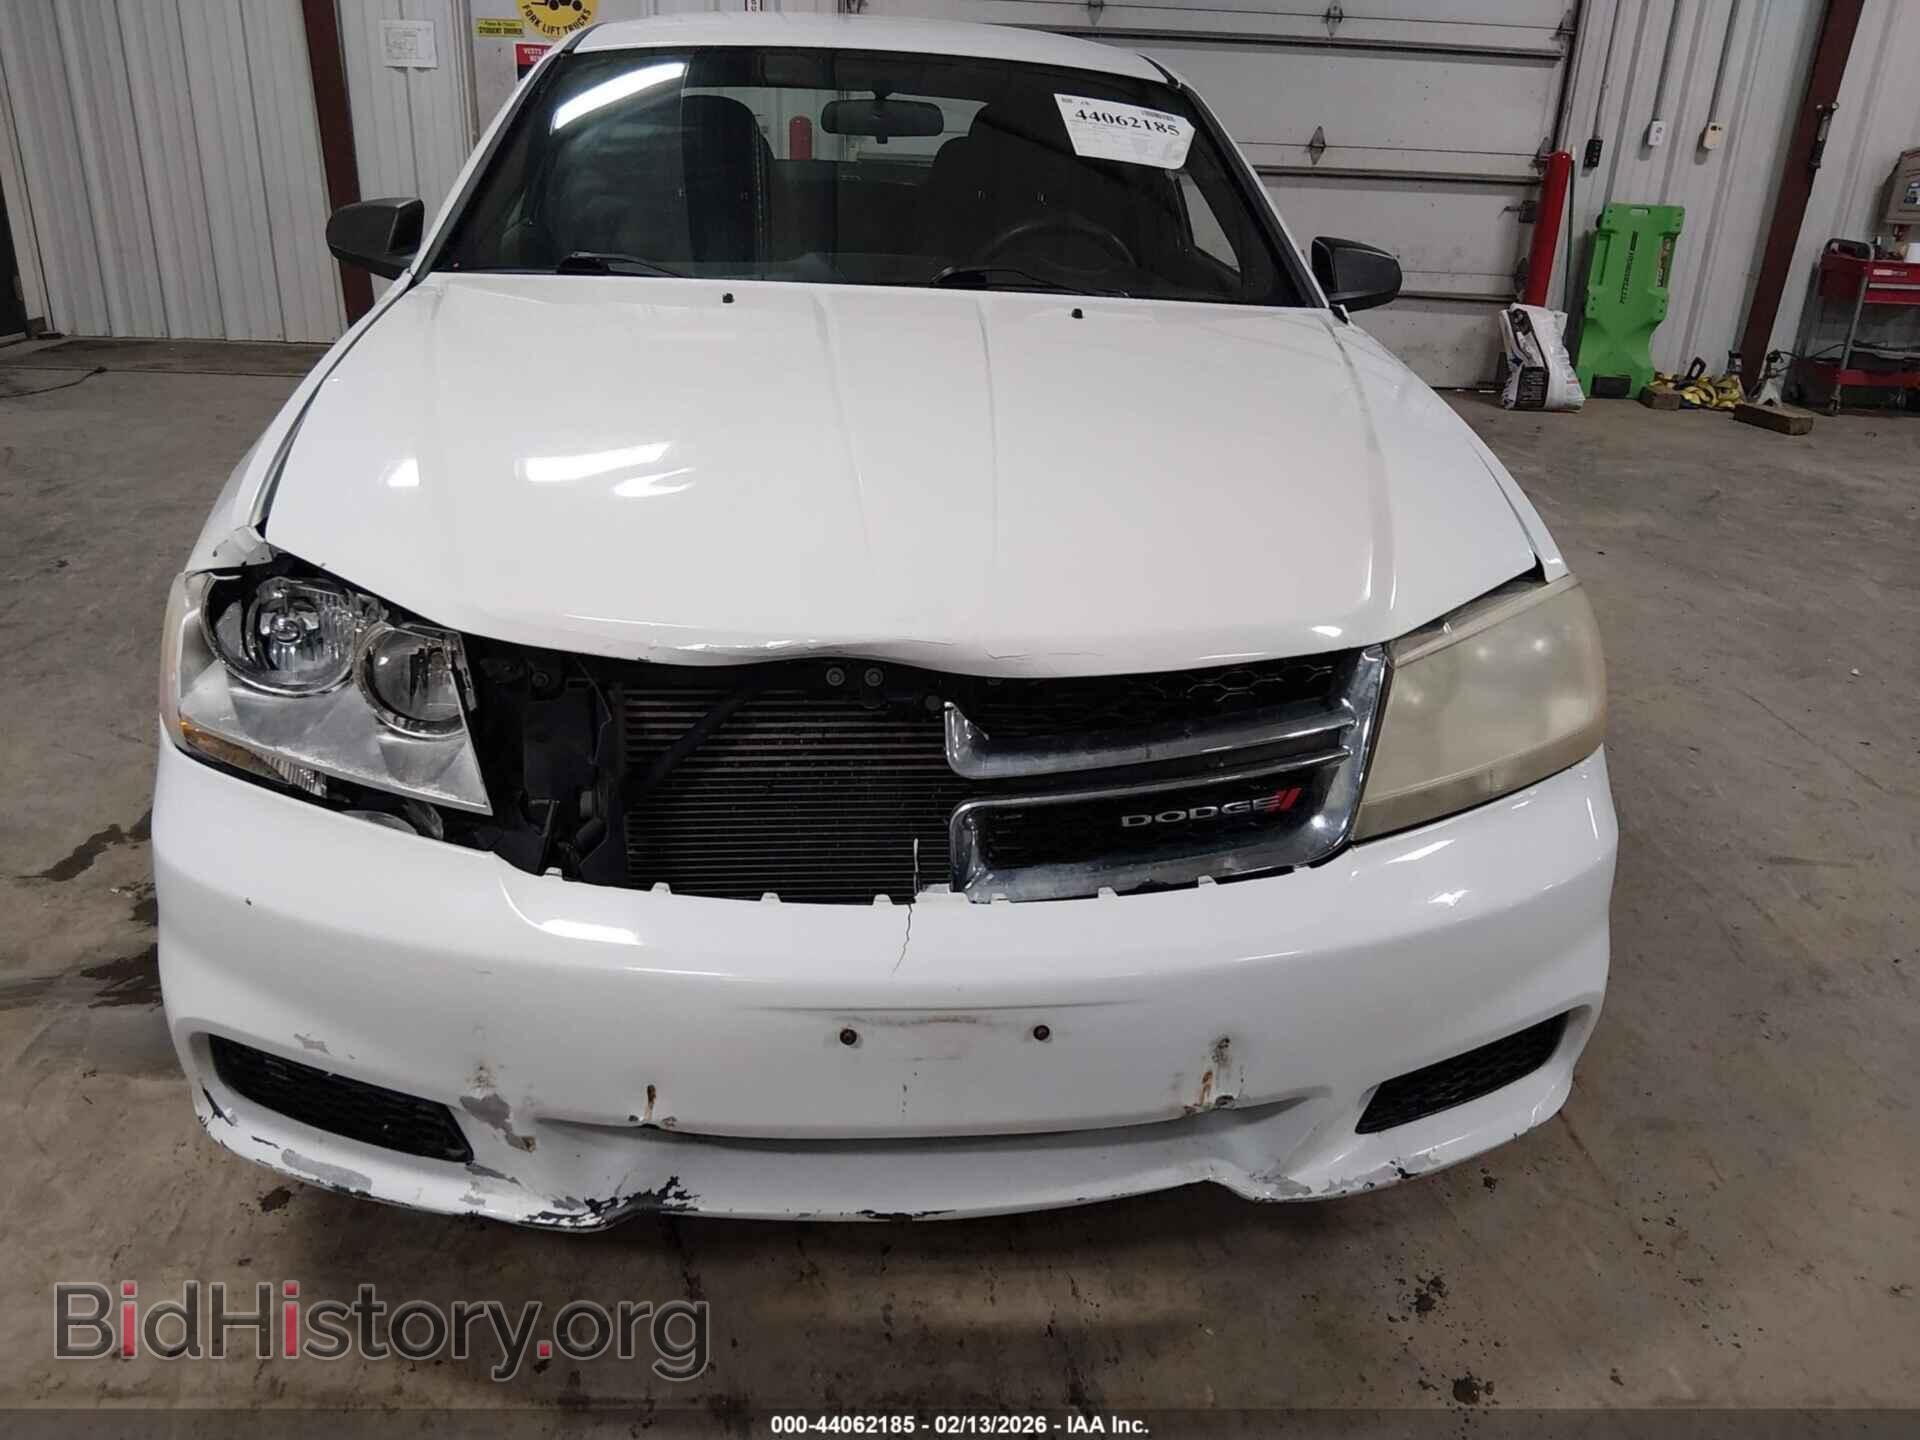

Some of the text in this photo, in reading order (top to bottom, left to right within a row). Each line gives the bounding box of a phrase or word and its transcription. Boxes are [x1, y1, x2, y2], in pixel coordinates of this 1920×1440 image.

[522, 4, 592, 36] FORK LIFT TRUCKS
[1075, 109, 1180, 136] 44062185
[1121, 795, 1281, 827] DODGE
